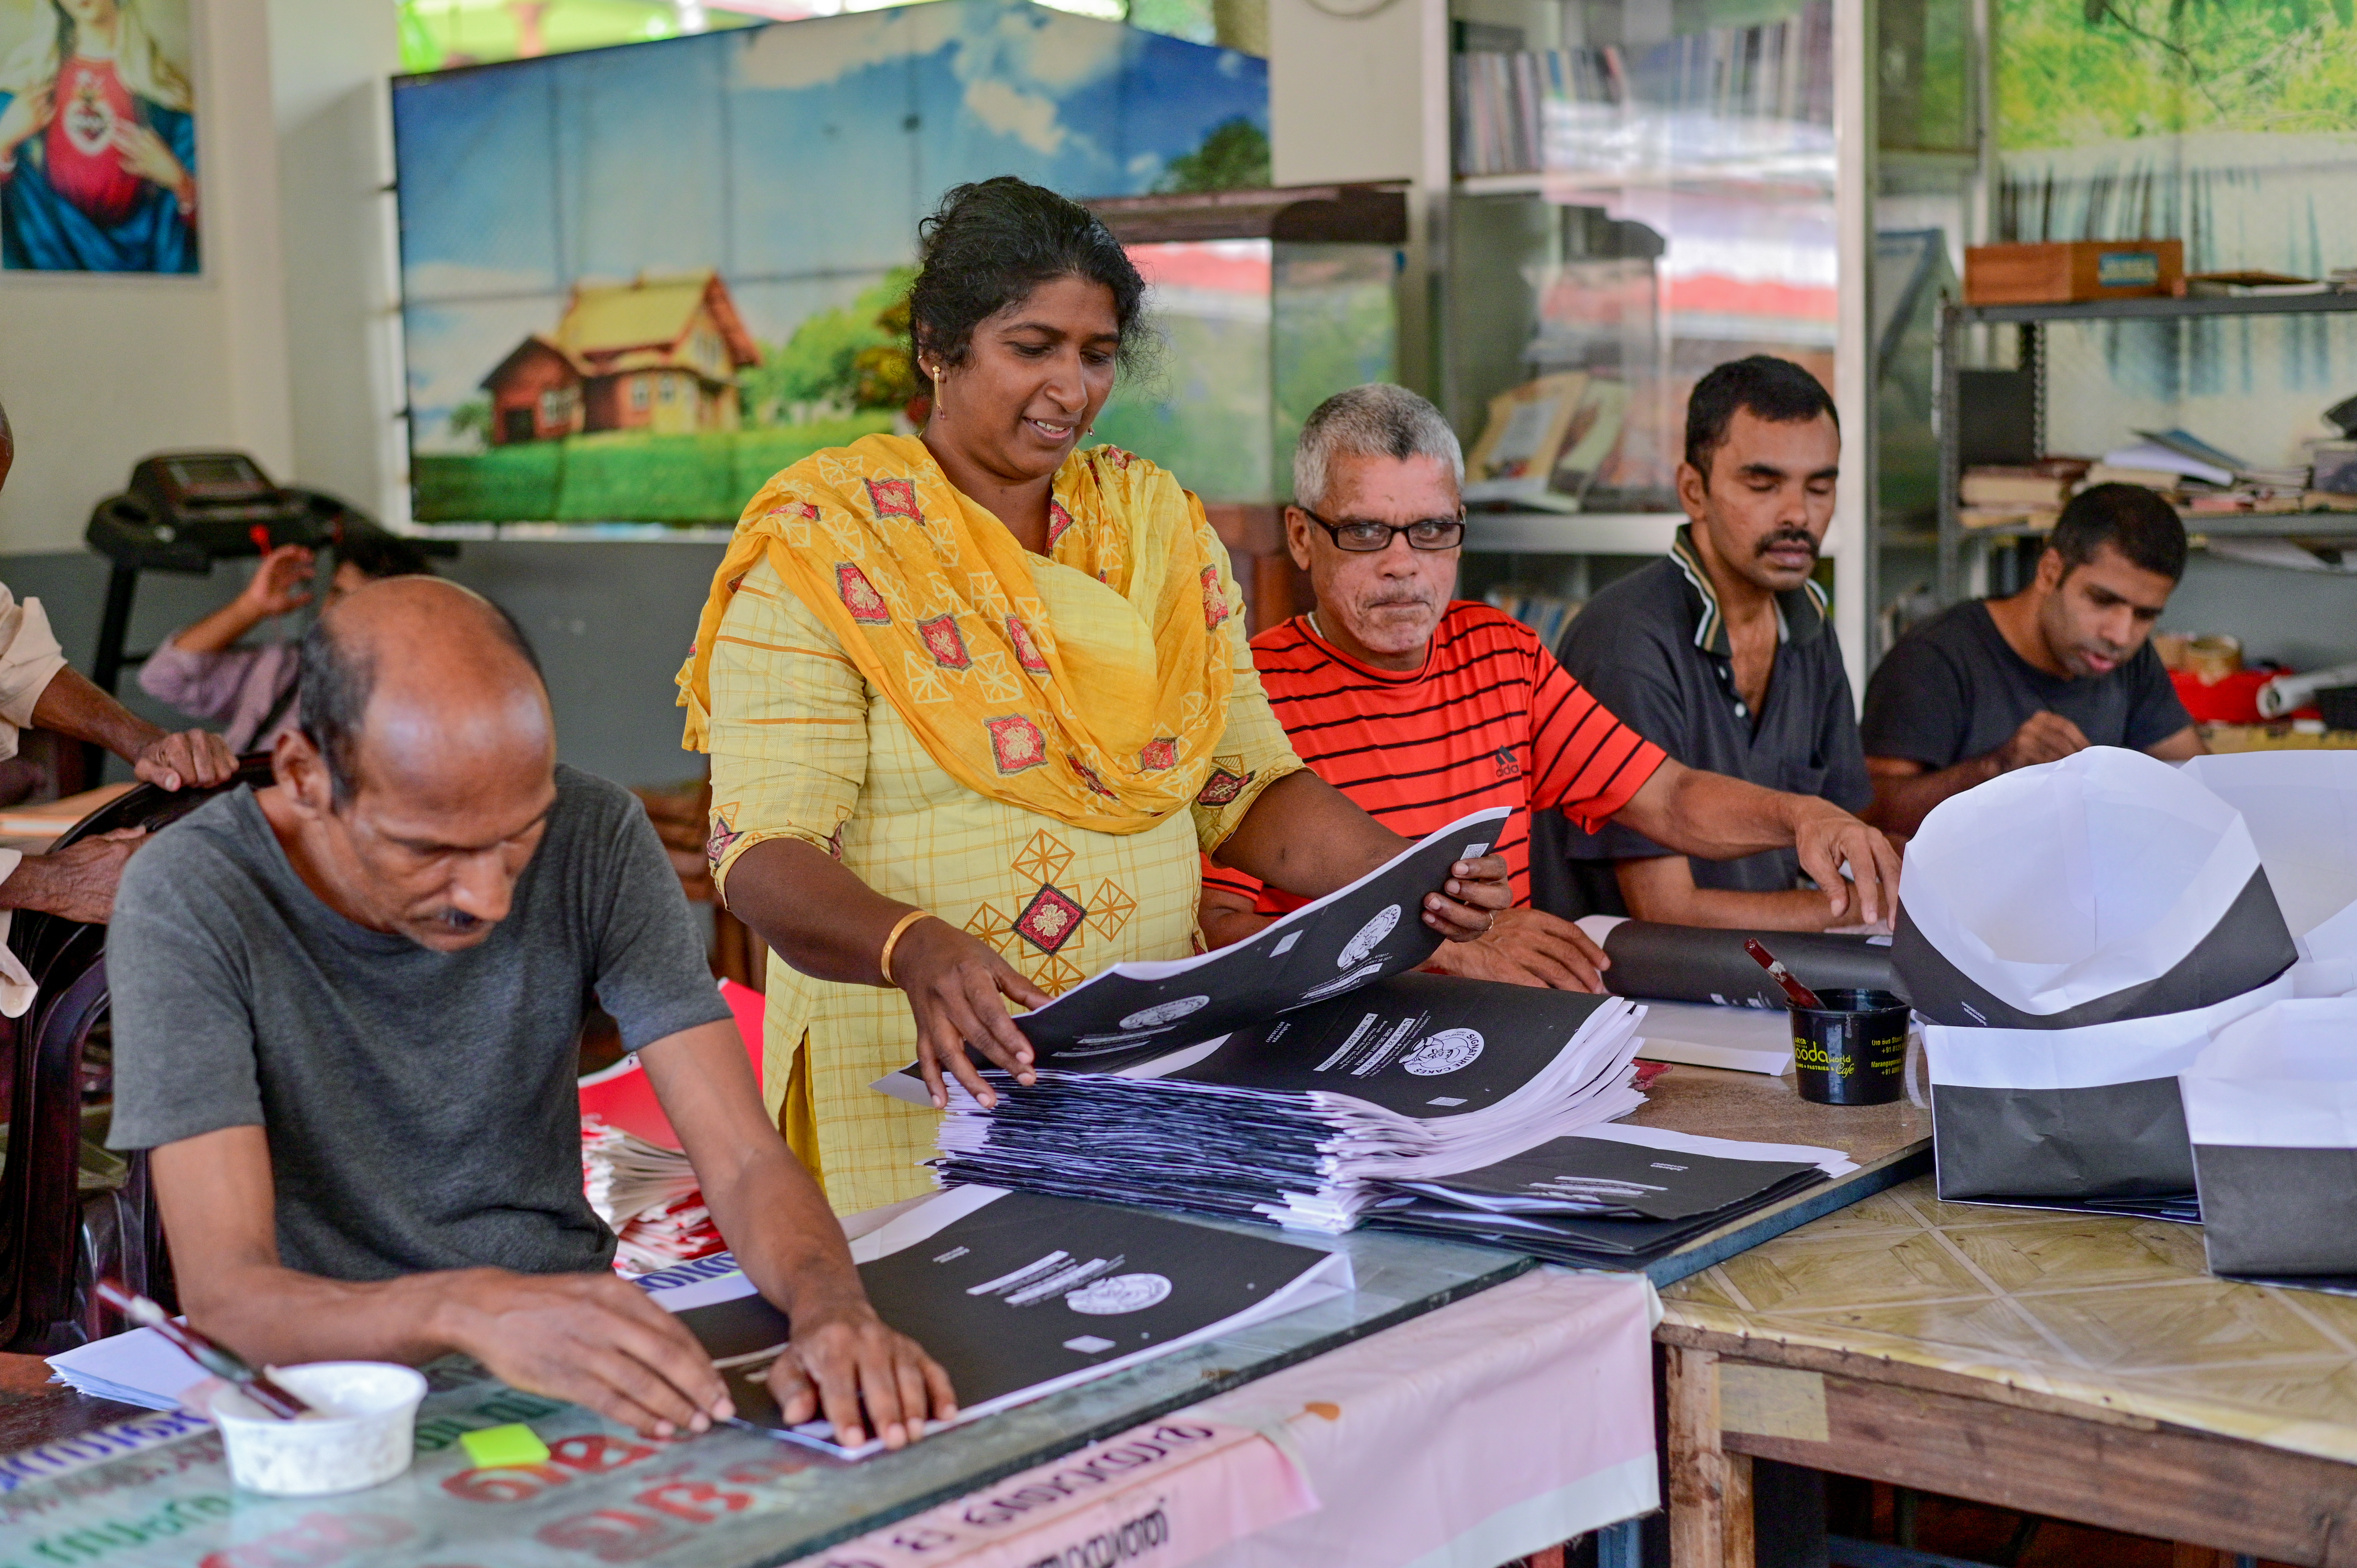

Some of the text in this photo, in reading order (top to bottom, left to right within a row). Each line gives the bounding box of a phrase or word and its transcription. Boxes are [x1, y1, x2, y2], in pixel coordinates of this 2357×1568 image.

[1272, 1023, 1292, 1043] Asharaya
[1355, 1024, 1368, 1037] 79077
[1376, 1020, 1388, 1033] Branch
[1382, 1027, 1395, 1038] HOME
[1397, 1025, 1408, 1035] 9061
[1344, 1037, 1357, 1049] 62277
[1370, 1037, 1387, 1052] DELIVERY
[1372, 1053, 1383, 1061] 9061
[1452, 1033, 1480, 1068] SIGNATURE
[1795, 1041, 1851, 1063] ooda world
[1836, 1062, 1855, 1078] Cafe
